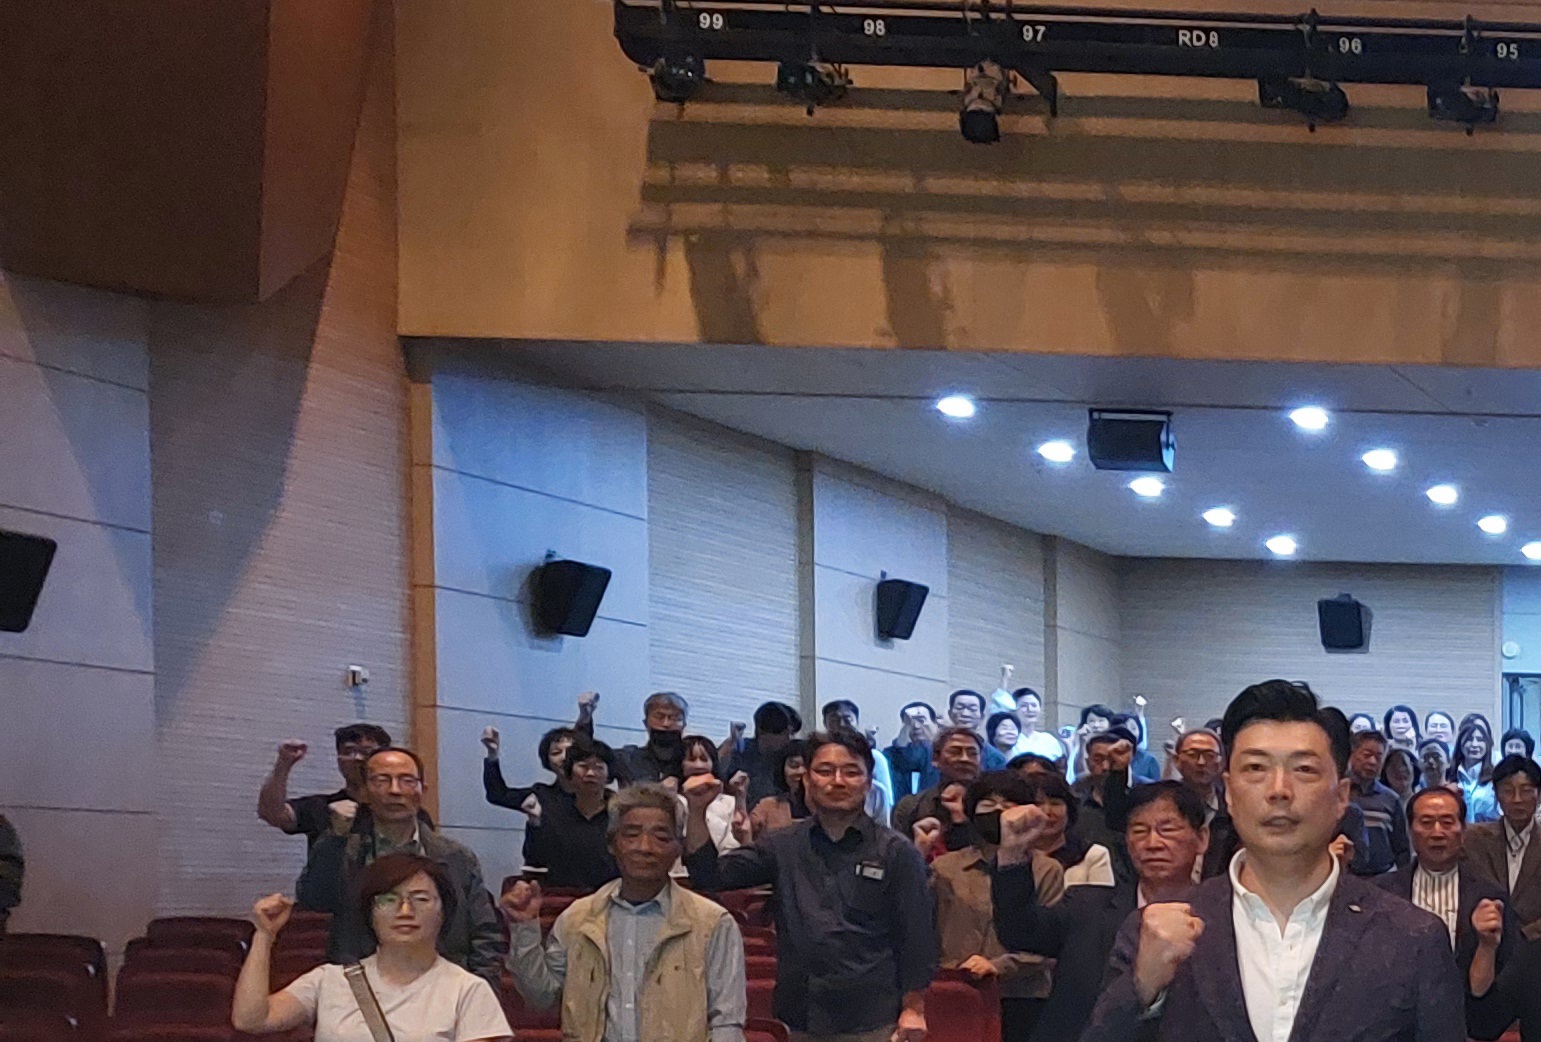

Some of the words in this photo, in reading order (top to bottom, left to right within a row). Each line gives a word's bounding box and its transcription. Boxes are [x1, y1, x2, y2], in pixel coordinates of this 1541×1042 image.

[699, 12, 724, 30] 99
[863, 19, 886, 36] 98
[1022, 25, 1046, 42] 97
[1339, 37, 1363, 54] 96
[1496, 42, 1519, 59] 95
